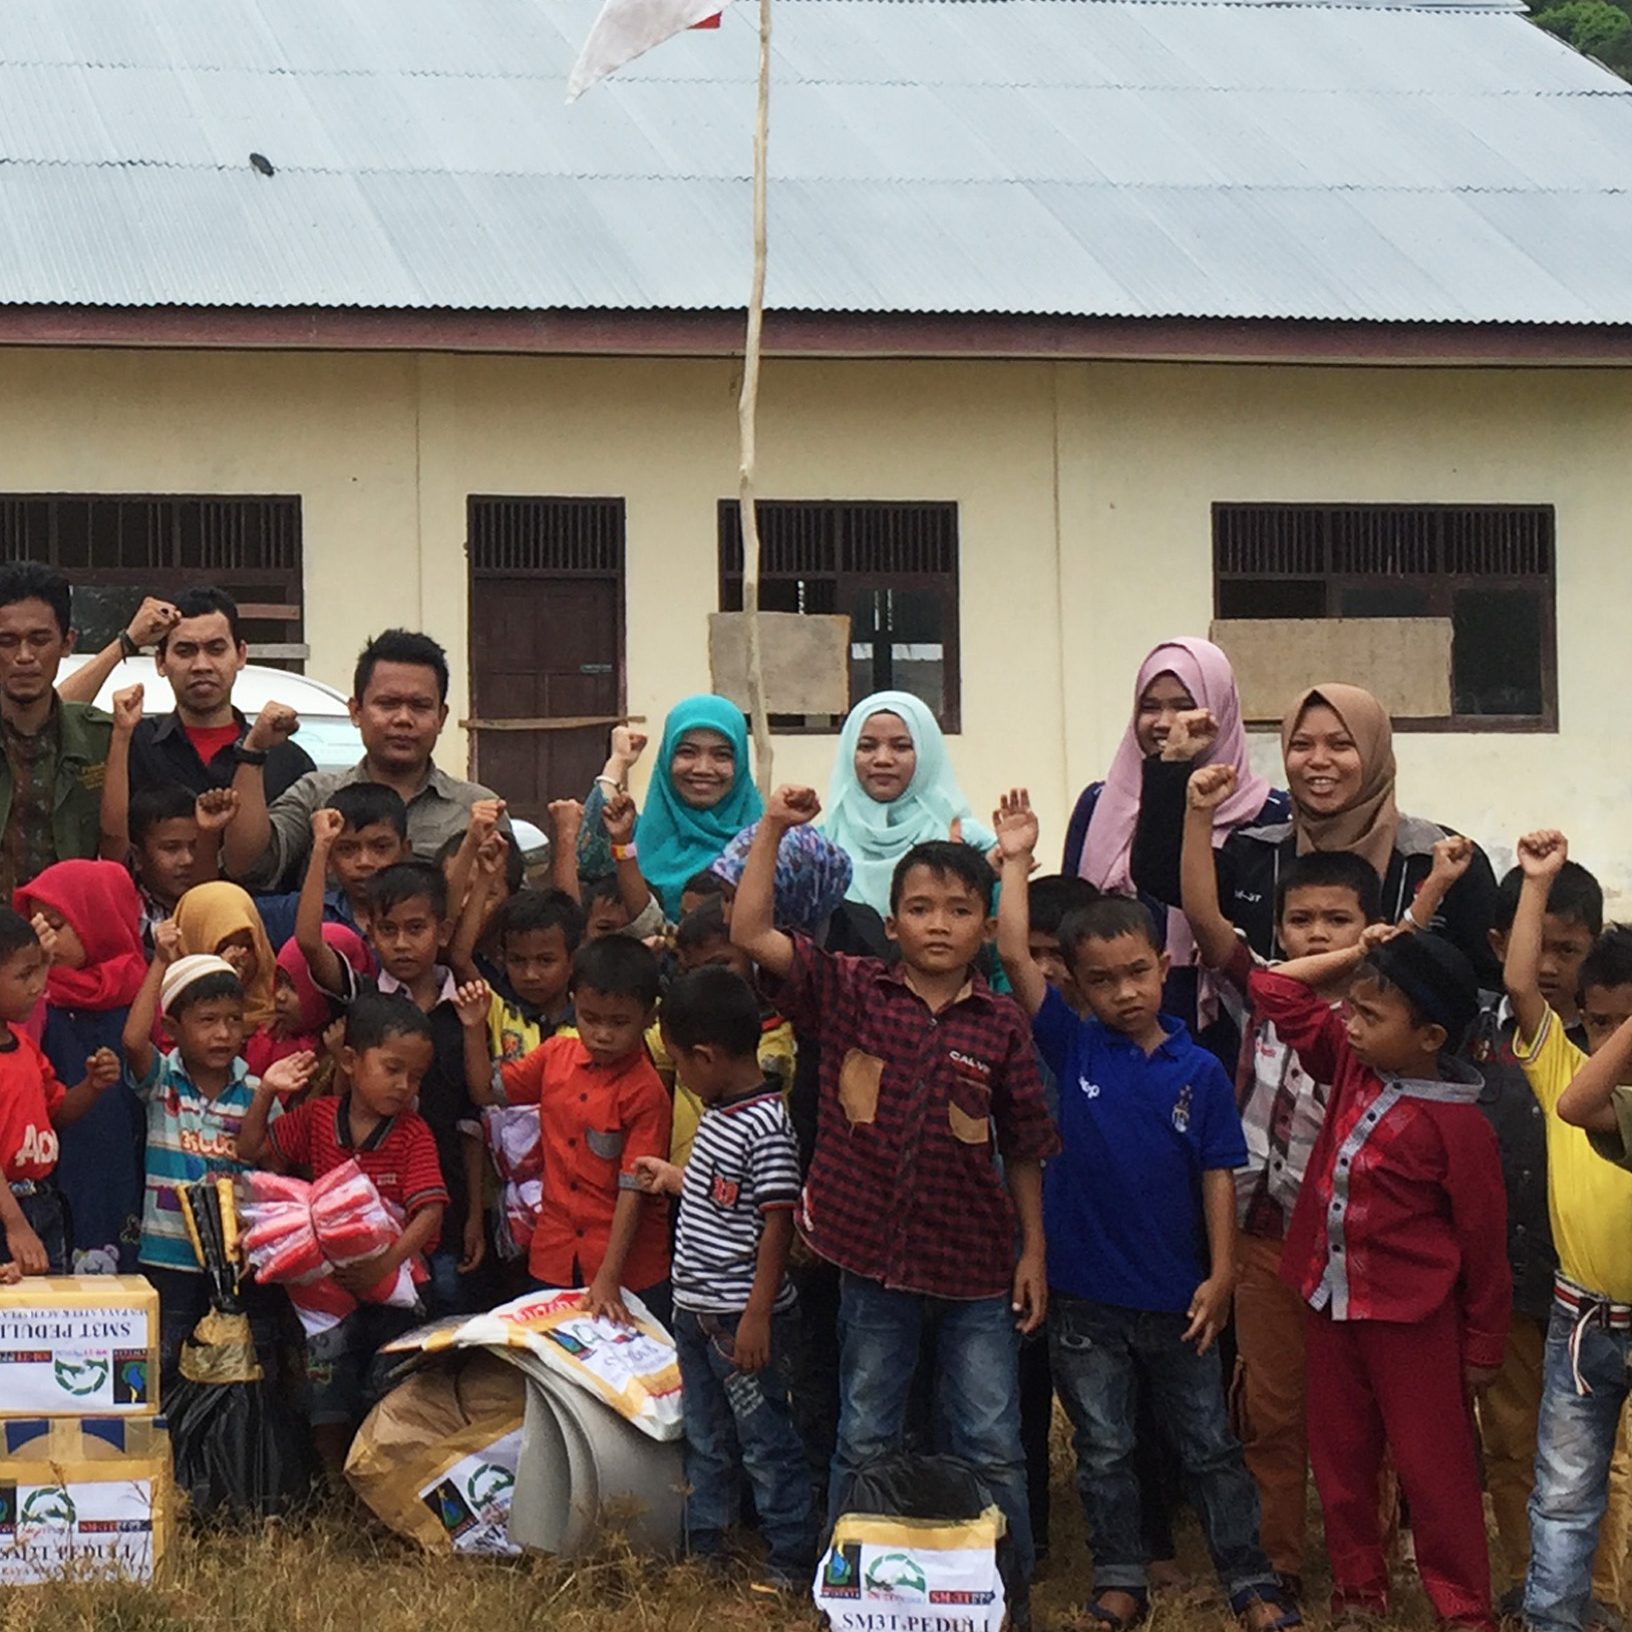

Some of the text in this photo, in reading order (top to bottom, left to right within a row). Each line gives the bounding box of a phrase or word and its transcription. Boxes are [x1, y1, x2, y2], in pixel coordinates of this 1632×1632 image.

[0, 1322, 131, 1339] SM3T PEDULI
[842, 1613, 990, 1632] SM3T PEDULI
